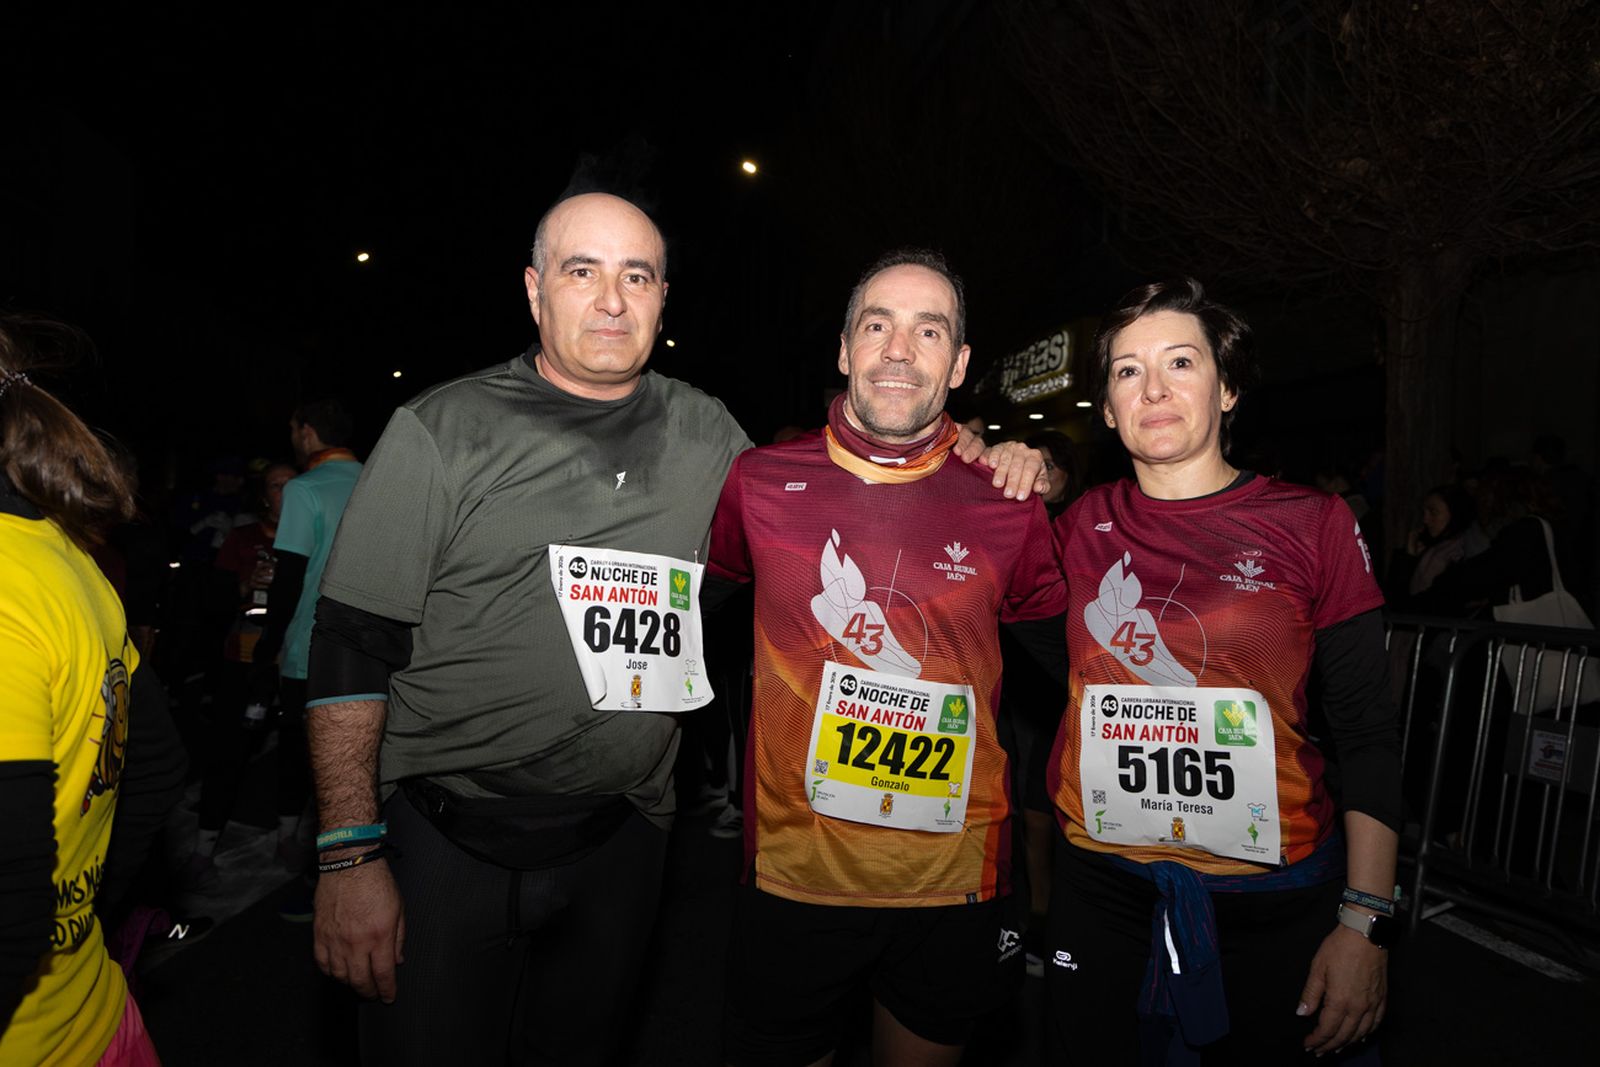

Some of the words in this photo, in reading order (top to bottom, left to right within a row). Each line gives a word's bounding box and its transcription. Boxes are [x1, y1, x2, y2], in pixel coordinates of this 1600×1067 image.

[590, 566, 639, 585] NOCHE
[641, 570, 658, 586] DE
[570, 584, 604, 602] SAN
[607, 585, 658, 607] ANTÓN
[583, 605, 681, 658] 6428
[842, 613, 885, 656] 43
[1109, 621, 1156, 667] 43
[626, 658, 648, 670] Jose
[858, 686, 909, 709] NOCHE
[910, 697, 931, 712] DE
[836, 700, 870, 721] SAN
[870, 708, 927, 732] ANTÓN
[1121, 704, 1175, 720] NOCHE
[1178, 706, 1197, 722] DE
[1101, 723, 1136, 741] SAN
[1139, 721, 1199, 745] ANTÓN
[836, 722, 956, 781] 12422
[871, 776, 911, 792] Gonzalo
[1118, 745, 1236, 801] 5165
[1140, 798, 1173, 812] María
[1176, 800, 1214, 816] Teresa
[168, 924, 190, 940] N
